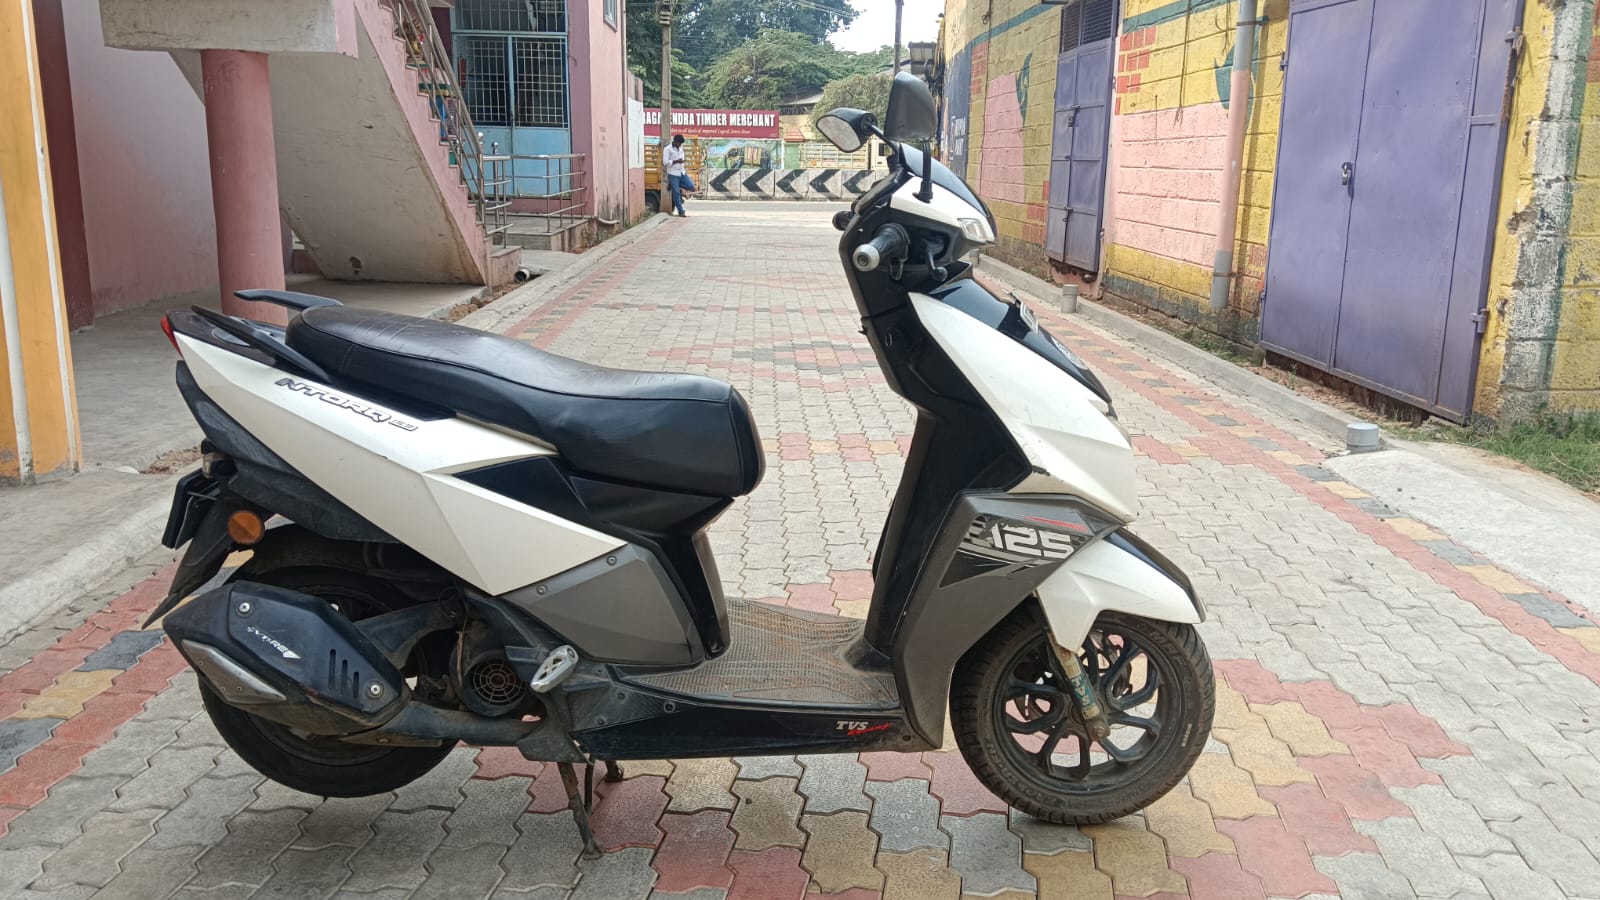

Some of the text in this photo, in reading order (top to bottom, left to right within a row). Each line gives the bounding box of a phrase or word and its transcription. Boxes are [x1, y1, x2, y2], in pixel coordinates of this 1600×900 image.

[695, 113, 727, 126] TIMBER
[729, 113, 775, 127] MERCHANT
[275, 378, 392, 423] NTORQ
[991, 523, 1074, 559] 125
[836, 721, 869, 731] TVS
